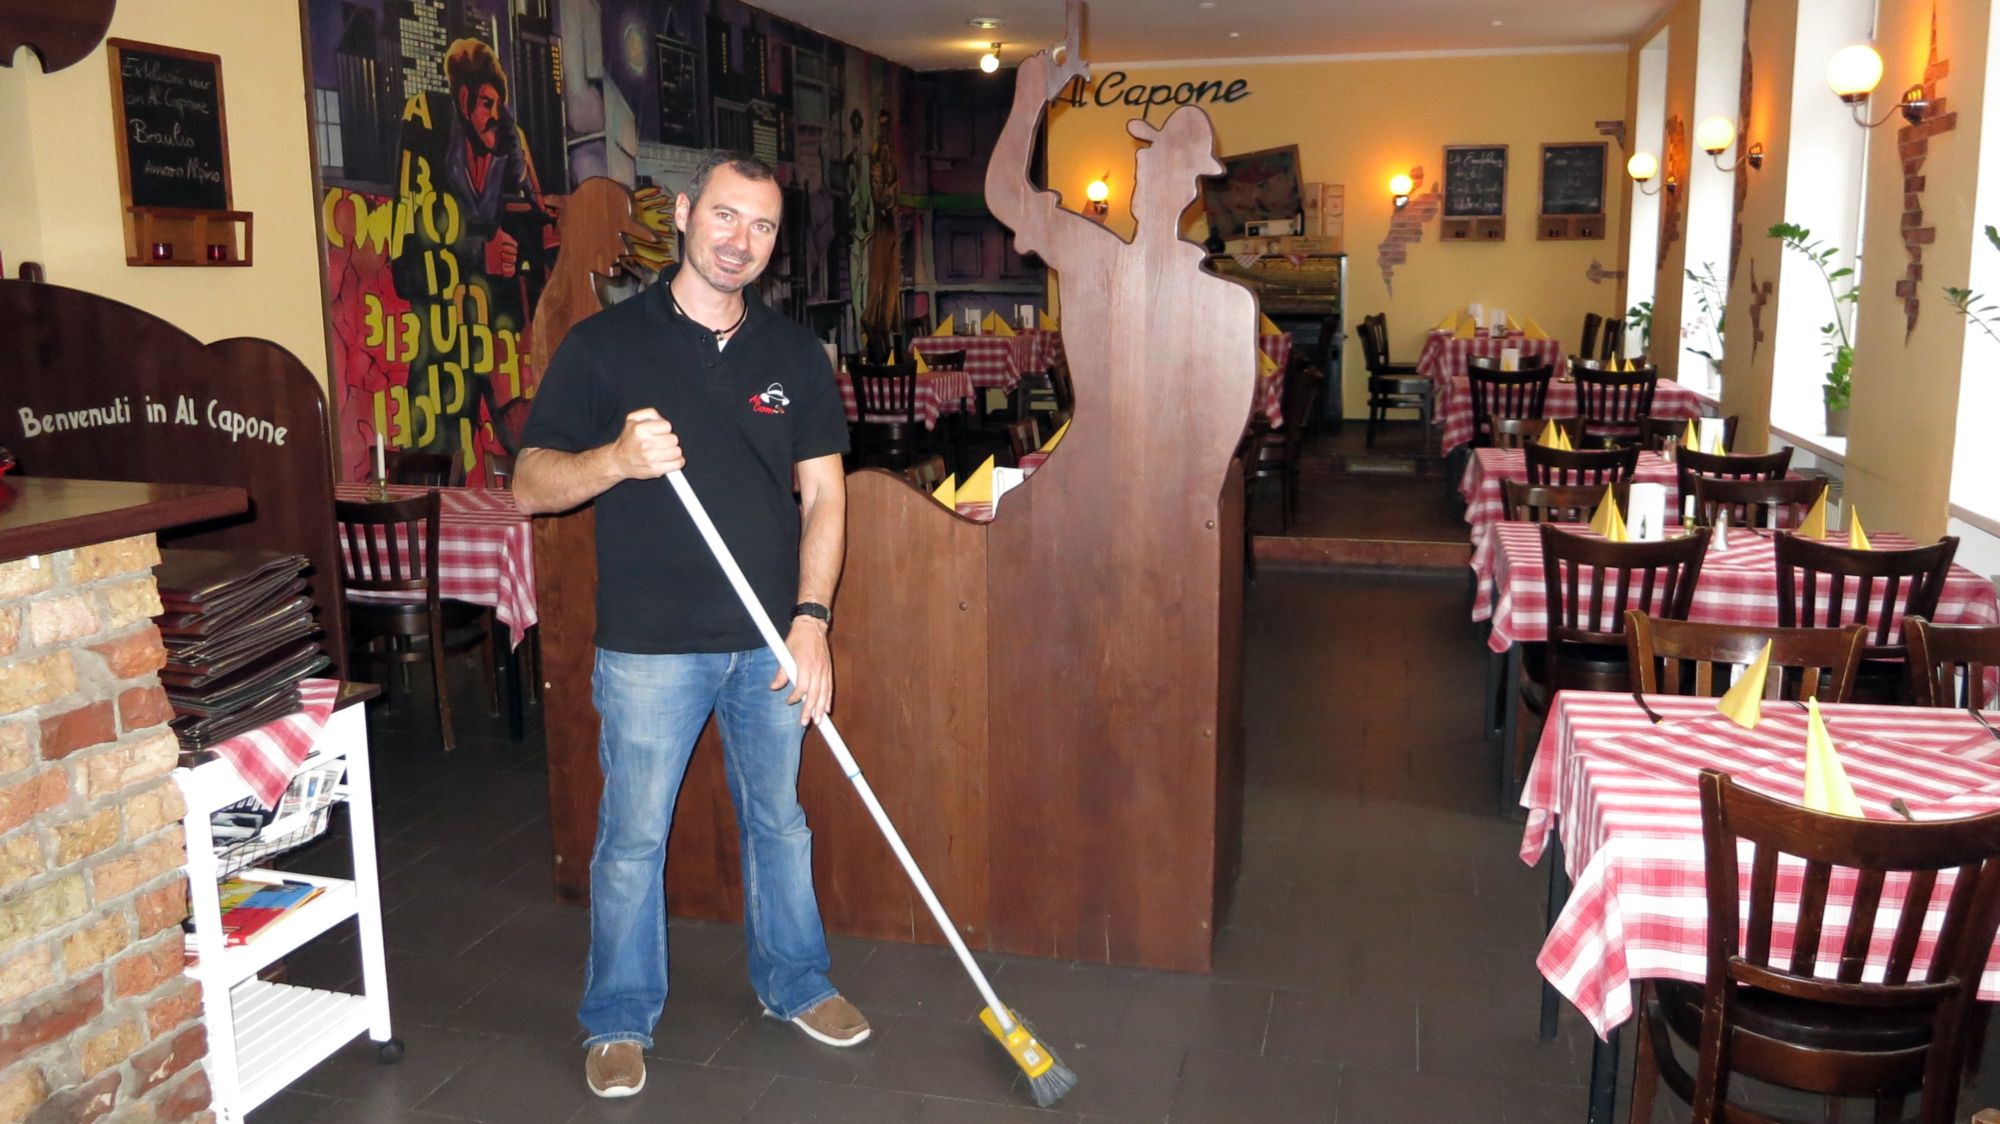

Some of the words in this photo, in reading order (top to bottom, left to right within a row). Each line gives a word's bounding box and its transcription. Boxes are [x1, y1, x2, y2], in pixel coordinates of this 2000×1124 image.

[1094, 71, 1253, 119] Capone
[129, 118, 195, 147] Braulio
[18, 396, 131, 438] Benvenuti
[145, 395, 167, 423] in
[174, 394, 198, 426] Al
[207, 399, 288, 446] Capone
